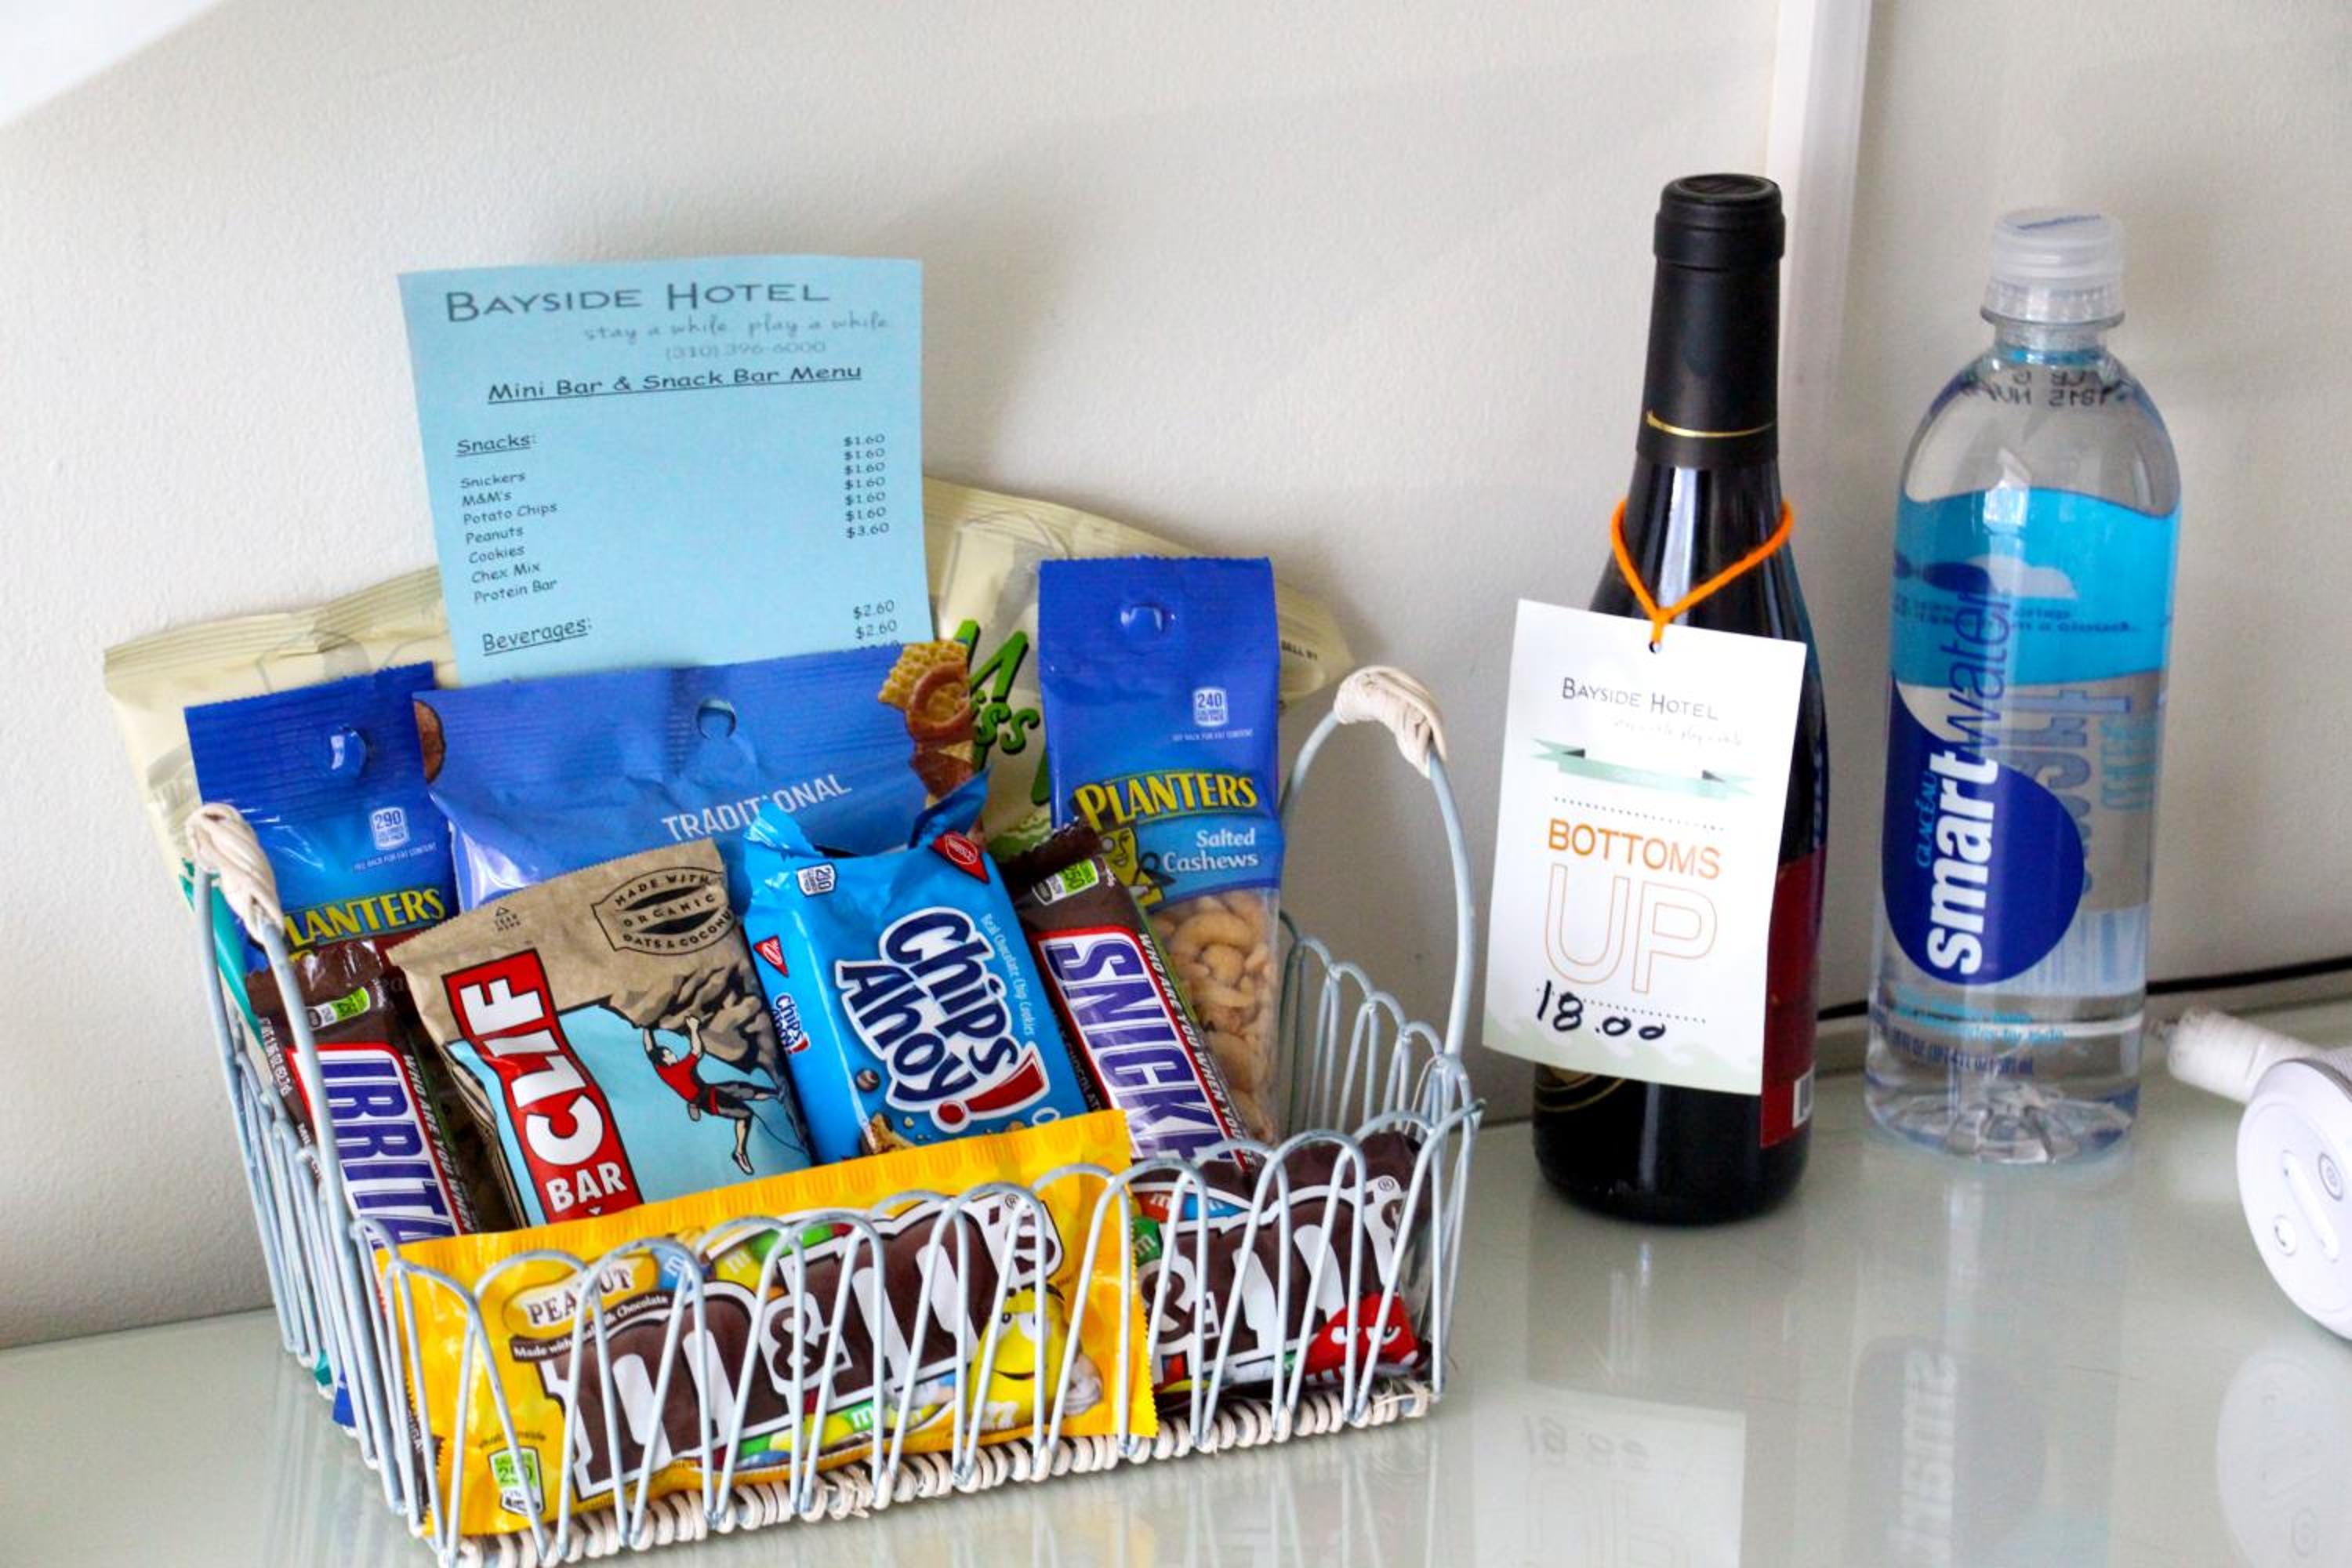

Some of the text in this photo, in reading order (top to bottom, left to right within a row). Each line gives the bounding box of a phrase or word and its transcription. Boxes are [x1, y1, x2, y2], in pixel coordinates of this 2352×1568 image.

[445, 281, 831, 323] BAYSIDE HOTEL
[584, 310, 890, 345] stay a while play a while
[488, 365, 862, 402] Mini Bar & Snack Bar Menu
[460, 471, 527, 489] Snickers
[462, 490, 513, 508] M&M's
[463, 502, 559, 525] Potato Chips
[466, 526, 524, 545] Peanuts
[468, 545, 526, 564] Cookies
[471, 561, 541, 584] Chex Mix
[474, 578, 558, 604] Protein Bar
[481, 616, 593, 653] Beverages:
[1196, 692, 1223, 709] 240
[1562, 677, 1719, 722] BAYSIDE HOTEL
[373, 809, 403, 830] 290
[1074, 772, 1259, 833] PLANTERS
[1196, 827, 1256, 848] Salted
[1548, 818, 1722, 880] BOTTOMS
[1163, 850, 1259, 873] Cashews
[615, 878, 659, 906] MADE
[285, 887, 446, 947] LANTERS
[623, 893, 715, 927] ORGANIC
[1544, 862, 1718, 995] UP
[883, 911, 1016, 1082] Chips
[1536, 979, 1667, 1041] 18.00
[840, 964, 1048, 1127] Ahoy!
[1176, 1014, 1201, 1049] YOU
[459, 977, 604, 1167] CLIF
[545, 1162, 627, 1214] BAR
[528, 1267, 633, 1325] PEAUT
[617, 1293, 668, 1318] Chocolate
